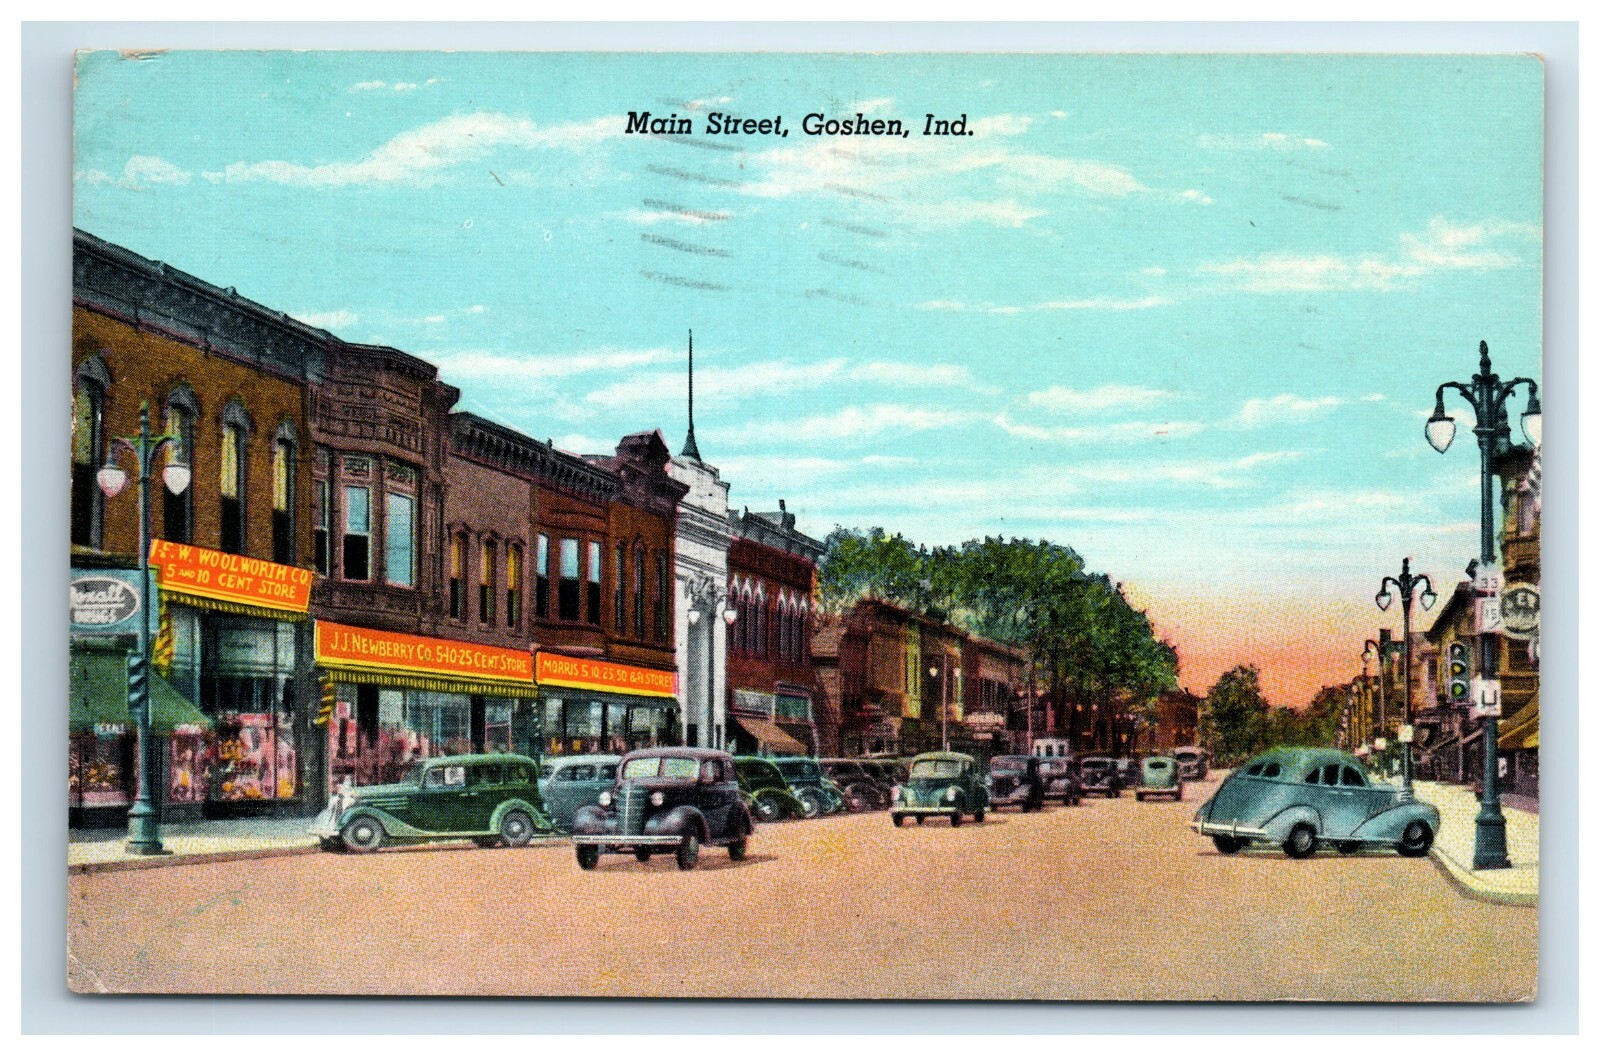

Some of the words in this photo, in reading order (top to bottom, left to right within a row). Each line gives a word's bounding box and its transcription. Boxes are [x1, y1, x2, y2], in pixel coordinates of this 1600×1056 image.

[165, 563, 177, 578] 5
[197, 569, 210, 584] 10
[217, 573, 254, 591] CENT
[258, 580, 297, 599] STORE
[199, 548, 287, 581] WOOLWORTH
[291, 567, 309, 587] CO.
[474, 651, 500, 670] CENT
[500, 654, 528, 674] STORE
[542, 660, 579, 677] MORRIS
[645, 673, 673, 688] STORES
